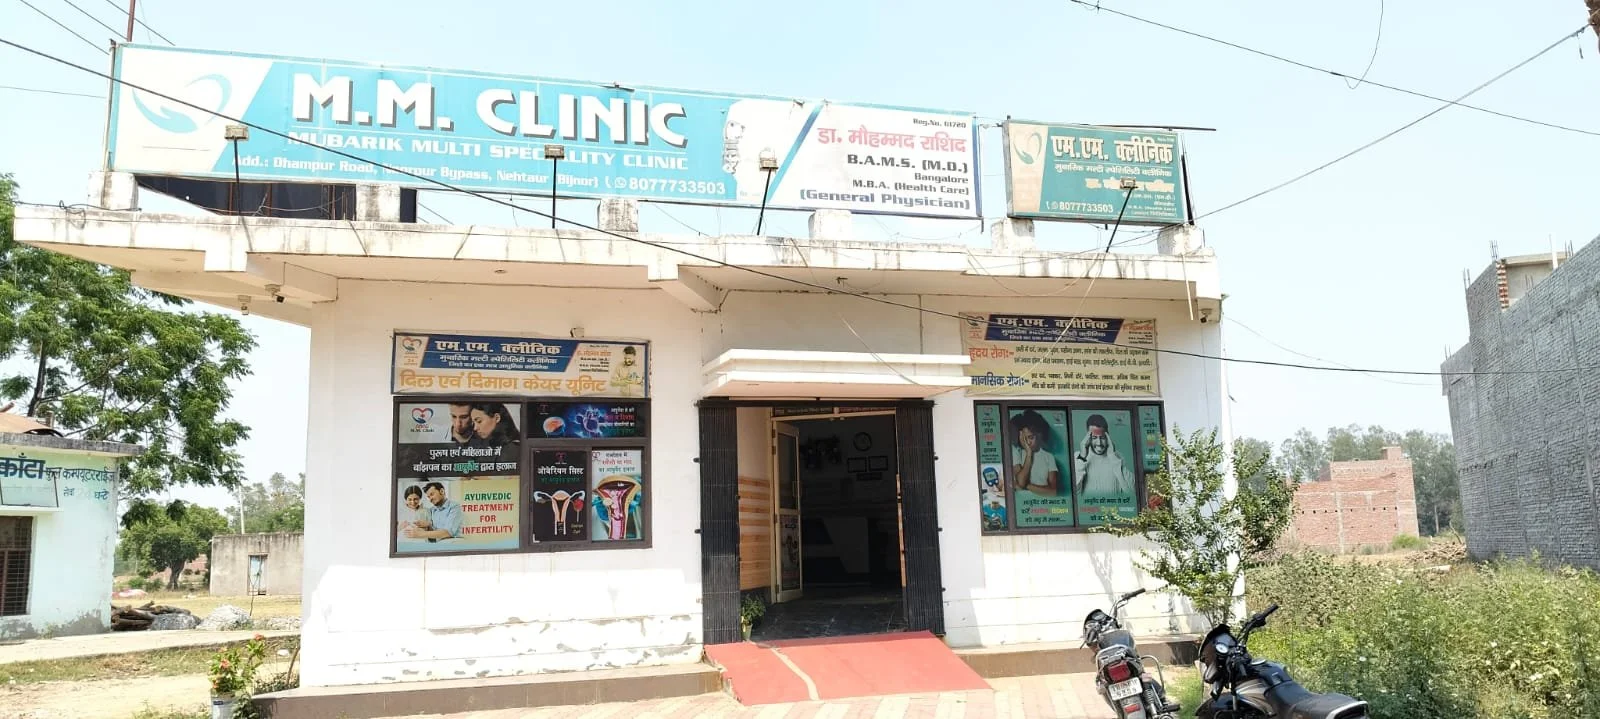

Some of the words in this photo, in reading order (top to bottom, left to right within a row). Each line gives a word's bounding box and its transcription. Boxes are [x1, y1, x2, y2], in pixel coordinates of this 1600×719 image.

[291, 74, 455, 132] M.M.
[476, 88, 688, 149] CLINIC
[288, 131, 403, 152] MUBARIK
[411, 139, 480, 157] MULTI
[489, 144, 617, 167] SPECLITY
[623, 154, 689, 171] CLINIC
[920, 132, 967, 153] राशिद
[1051, 136, 1110, 161] एम.एम.
[1114, 135, 1174, 164] क्लीनिक
[847, 153, 916, 169] B.A.M.S.
[921, 159, 968, 174] (M.D.)
[273, 156, 336, 172] Dhampur
[339, 161, 378, 175] Road,
[440, 166, 492, 182] Bypass,
[496, 169, 549, 184] Nehtaur
[629, 177, 726, 195] 8077733503
[914, 172, 969, 184] Bangalore
[852, 179, 891, 190] M.B.A.
[894, 182, 937, 194] (Health
[940, 184, 970, 196] Care)
[800, 188, 877, 204] (General
[881, 192, 971, 210] Physician)
[1058, 200, 1114, 214] 8077733503
[996, 317, 1049, 328] एम.एम.
[435, 341, 494, 353] एम.एम.
[500, 342, 562, 355] क्लीनिक
[400, 369, 433, 389] दिल
[438, 371, 465, 389] एवं
[467, 371, 518, 390] दिमाग
[522, 374, 561, 391] केयर
[565, 375, 607, 395] यूनिट
[0, 452, 46, 480] काँटा
[464, 492, 512, 501] AYURVEDIC
[462, 503, 514, 512] TREATMENT
[479, 514, 497, 523] FOR
[462, 525, 514, 535] INFERTILITY
